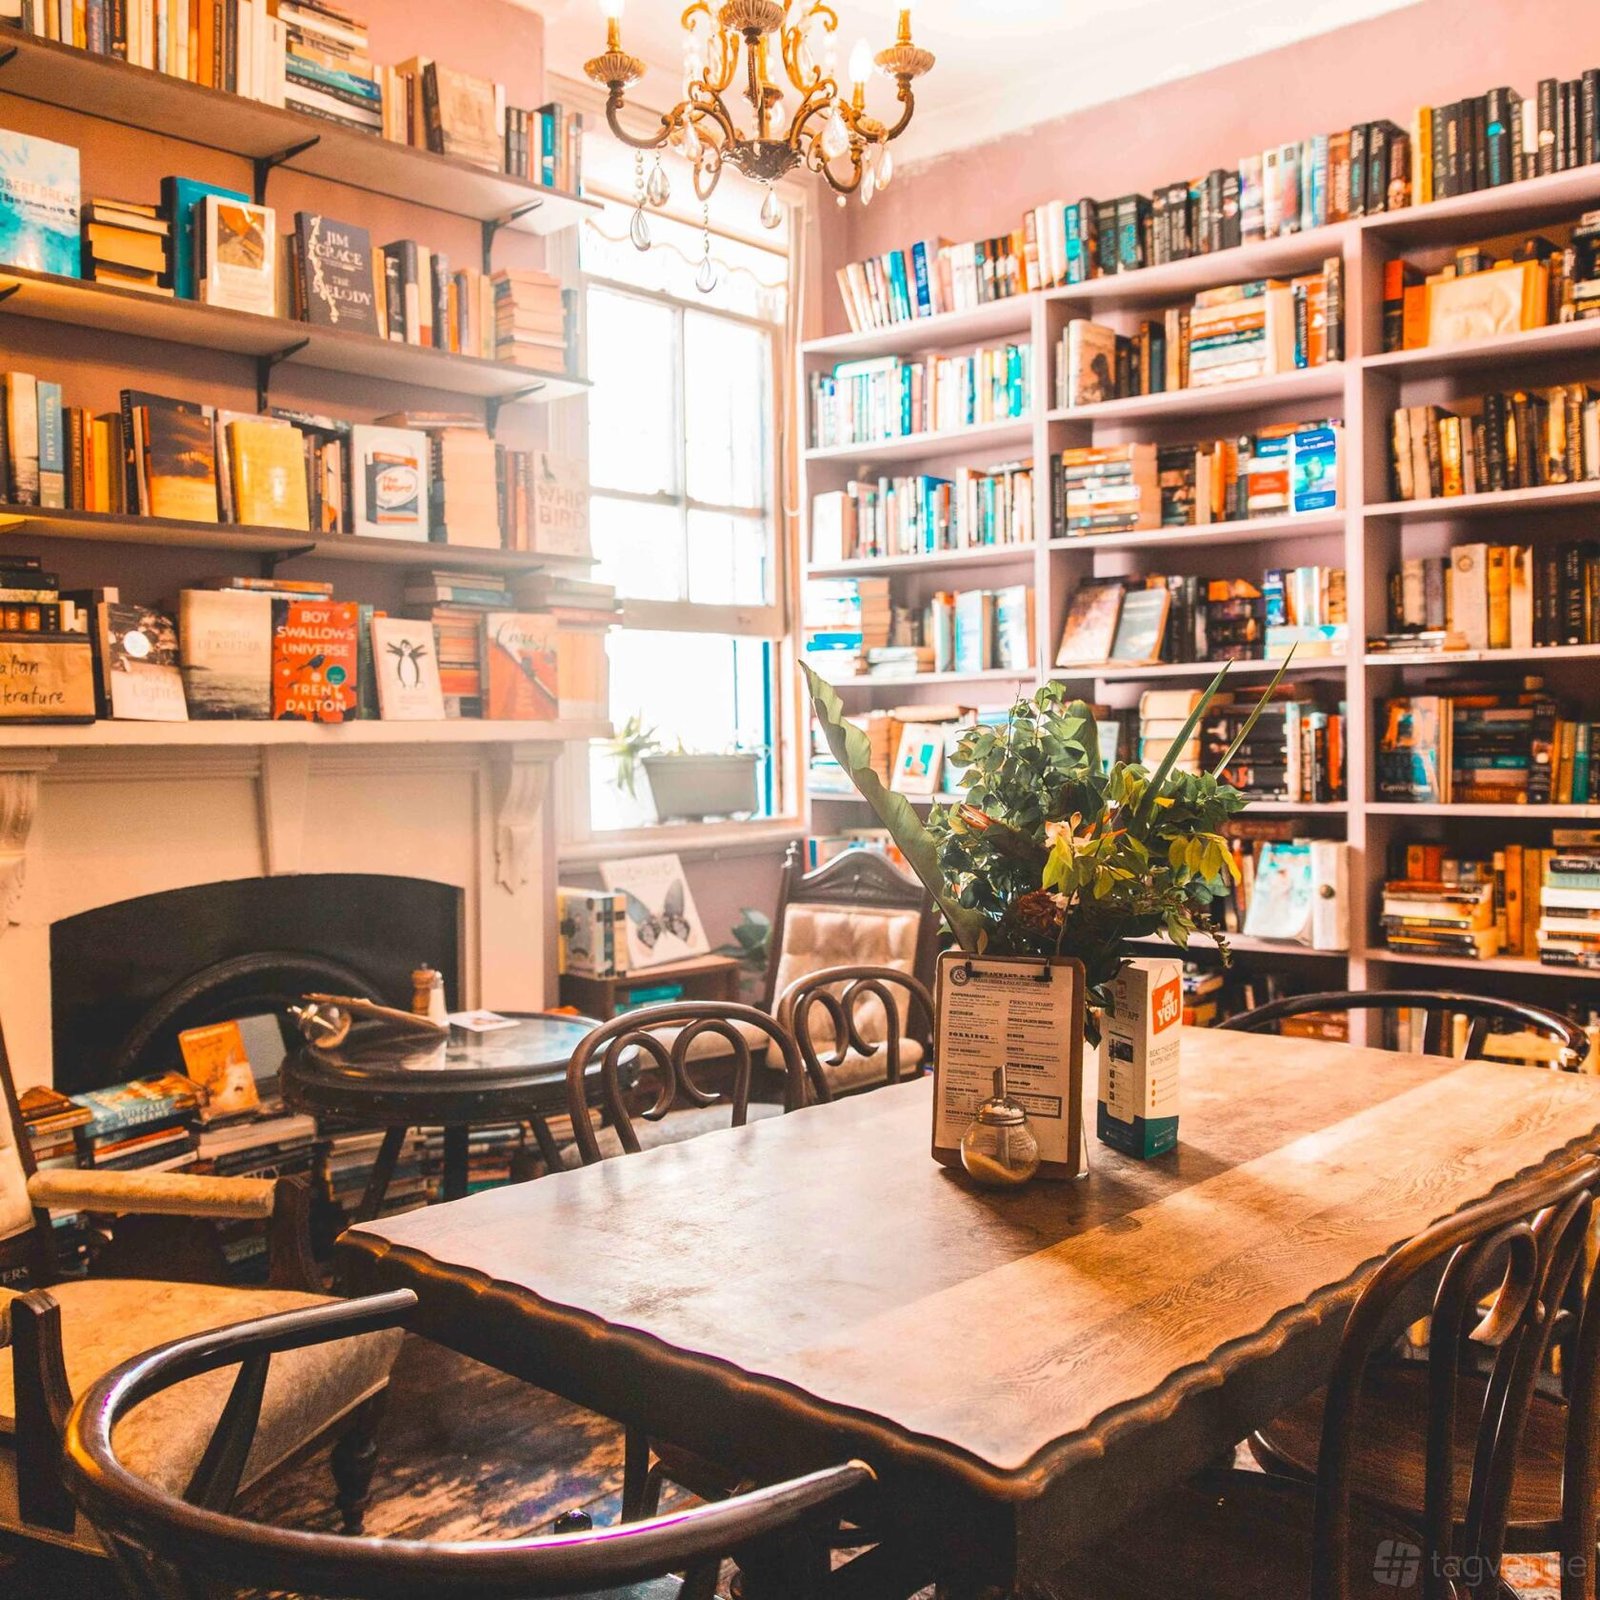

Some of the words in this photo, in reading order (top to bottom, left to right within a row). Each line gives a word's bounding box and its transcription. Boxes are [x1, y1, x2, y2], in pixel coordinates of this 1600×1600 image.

[324, 231, 349, 248] JIM
[301, 610, 331, 623] BOY
[276, 625, 355, 641] SWALLOWS
[282, 643, 350, 657] UNIVERSE
[292, 683, 343, 699] TRENT
[285, 699, 347, 712] DALTON
[1157, 999, 1179, 1027] YOU
